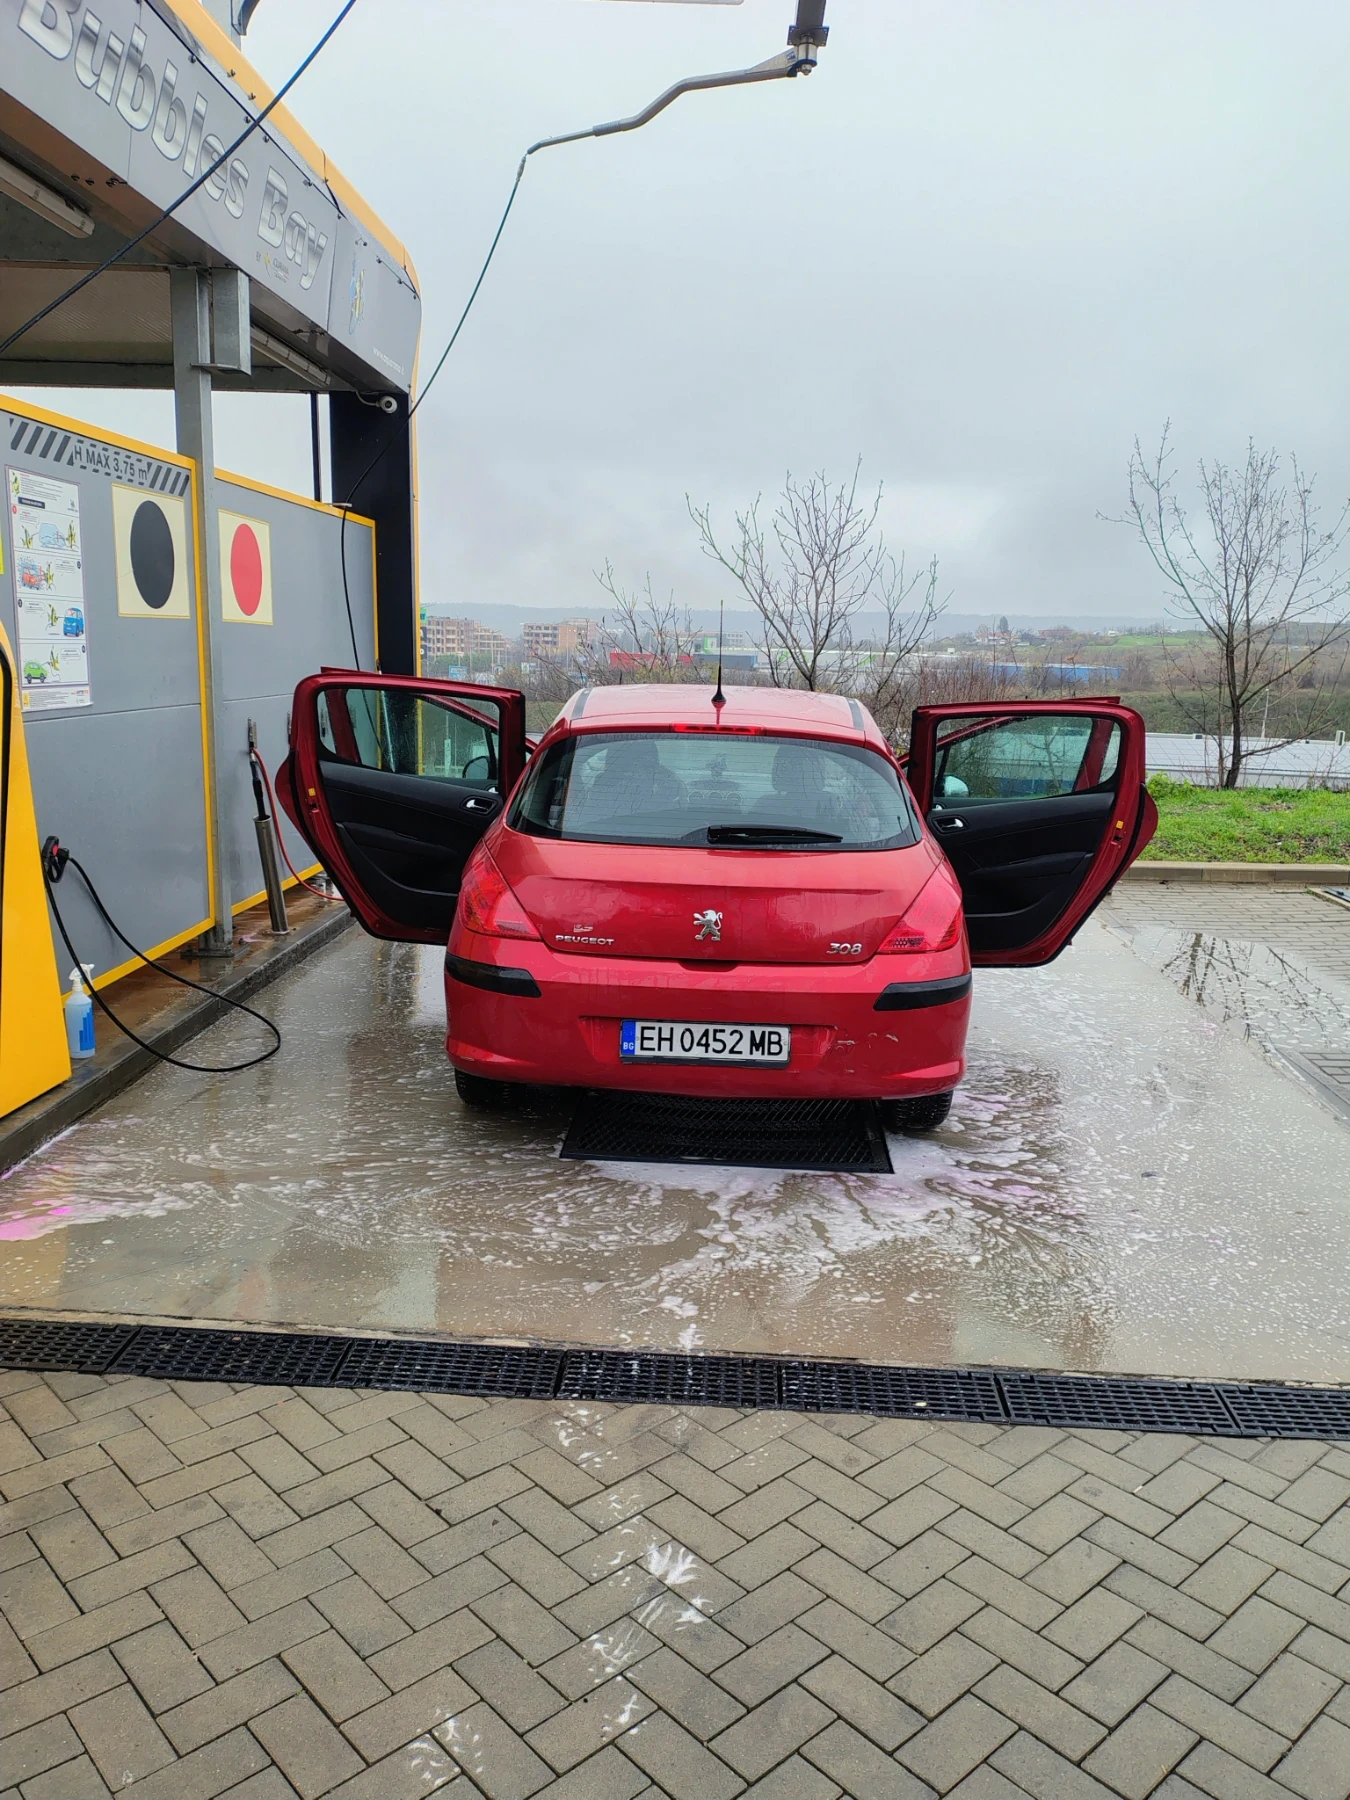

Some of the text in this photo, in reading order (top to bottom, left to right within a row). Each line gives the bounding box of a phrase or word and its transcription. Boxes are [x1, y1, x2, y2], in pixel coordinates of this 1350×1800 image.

[17, 0, 329, 290] Bubbles Bay
[74, 445, 148, 480] H MAX 3.75 m
[555, 935, 615, 946] PEUGEOT
[826, 943, 862, 954] 308
[623, 1042, 634, 1050] BG
[640, 1026, 783, 1056] EH 0452 MB
